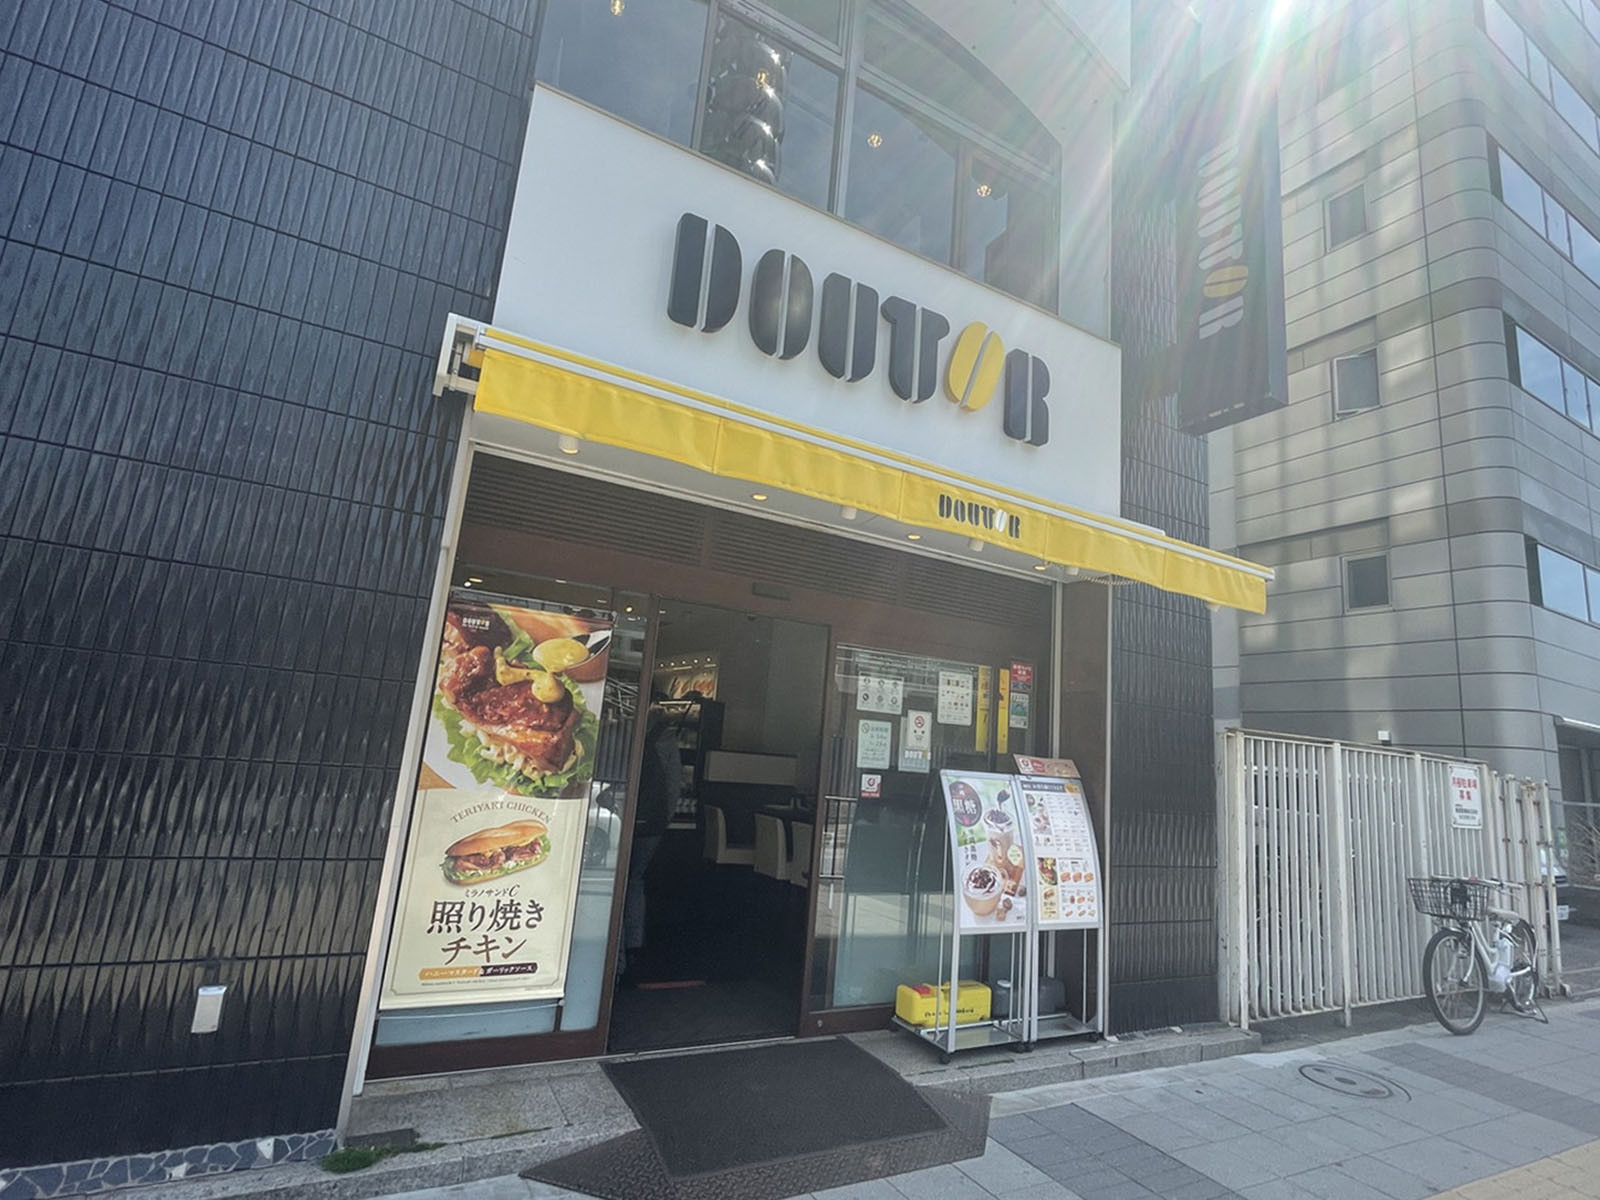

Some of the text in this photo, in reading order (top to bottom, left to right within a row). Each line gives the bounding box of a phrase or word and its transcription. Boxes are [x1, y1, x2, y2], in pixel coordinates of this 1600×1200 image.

[1198, 137, 1249, 340] DOUTOR
[667, 212, 1051, 448] DOUTOR
[938, 493, 1021, 539] DOUTOR
[450, 801, 553, 824] TERIYAKI CHICKEN
[465, 884, 520, 898] ミラノサンドC
[426, 899, 545, 934] 照り焼き
[441, 934, 527, 965] チキン
